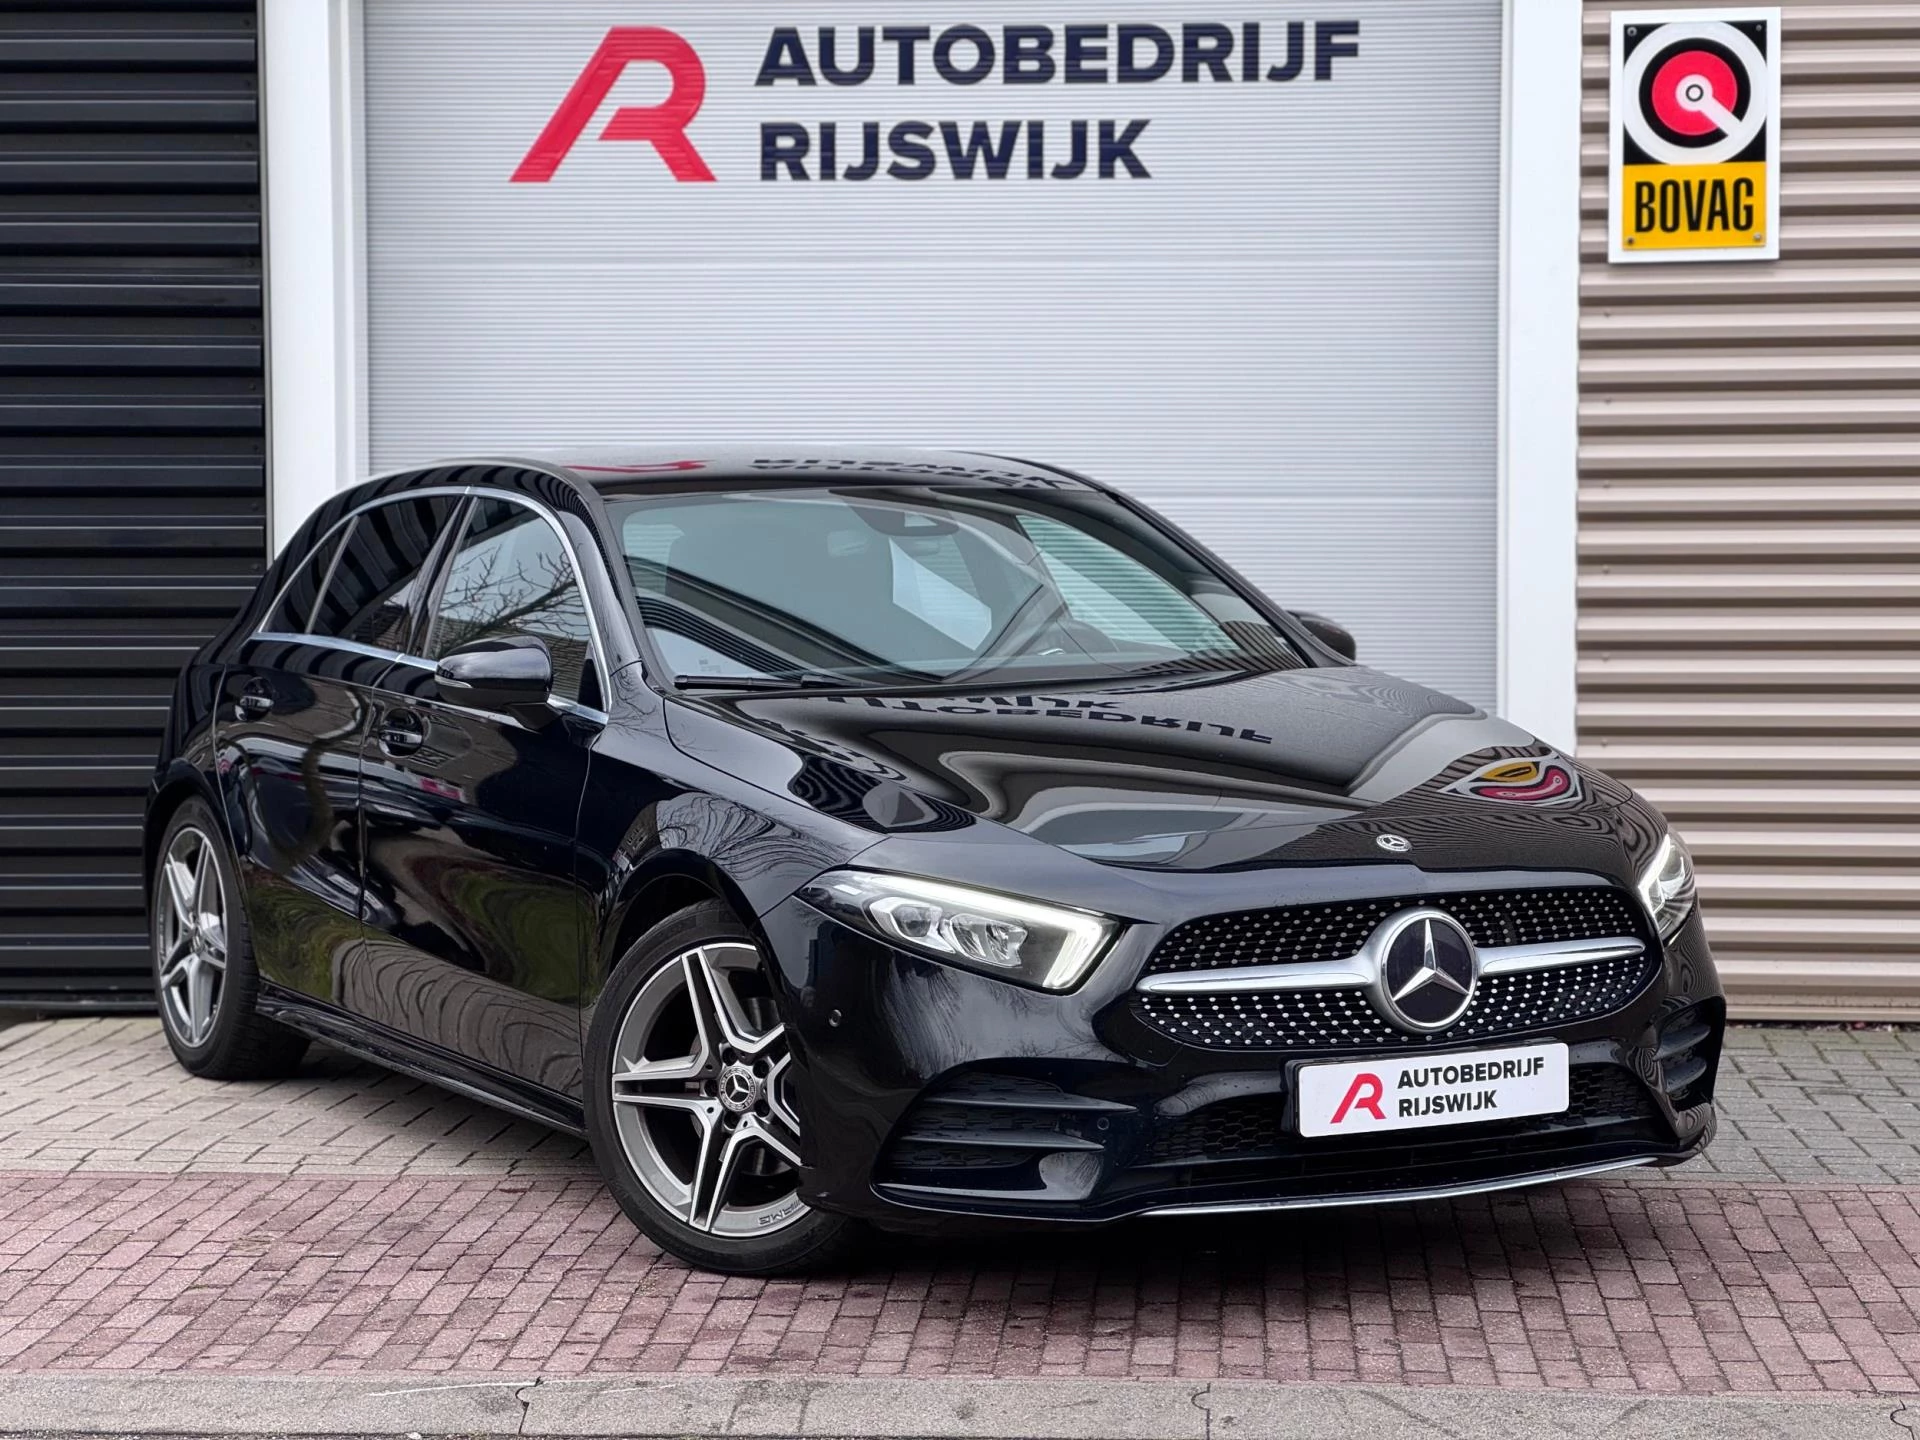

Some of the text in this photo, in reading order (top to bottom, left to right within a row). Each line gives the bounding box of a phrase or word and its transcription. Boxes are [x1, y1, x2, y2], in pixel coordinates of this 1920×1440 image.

[756, 20, 1360, 86] AUTOBEDRIJF
[761, 119, 1152, 181] RIJSWIJK
[1635, 177, 1754, 233] BOVAG
[1397, 1056, 1545, 1089] AUTOBEDRIJF
[1398, 1089, 1498, 1118] RIJSWIJK
